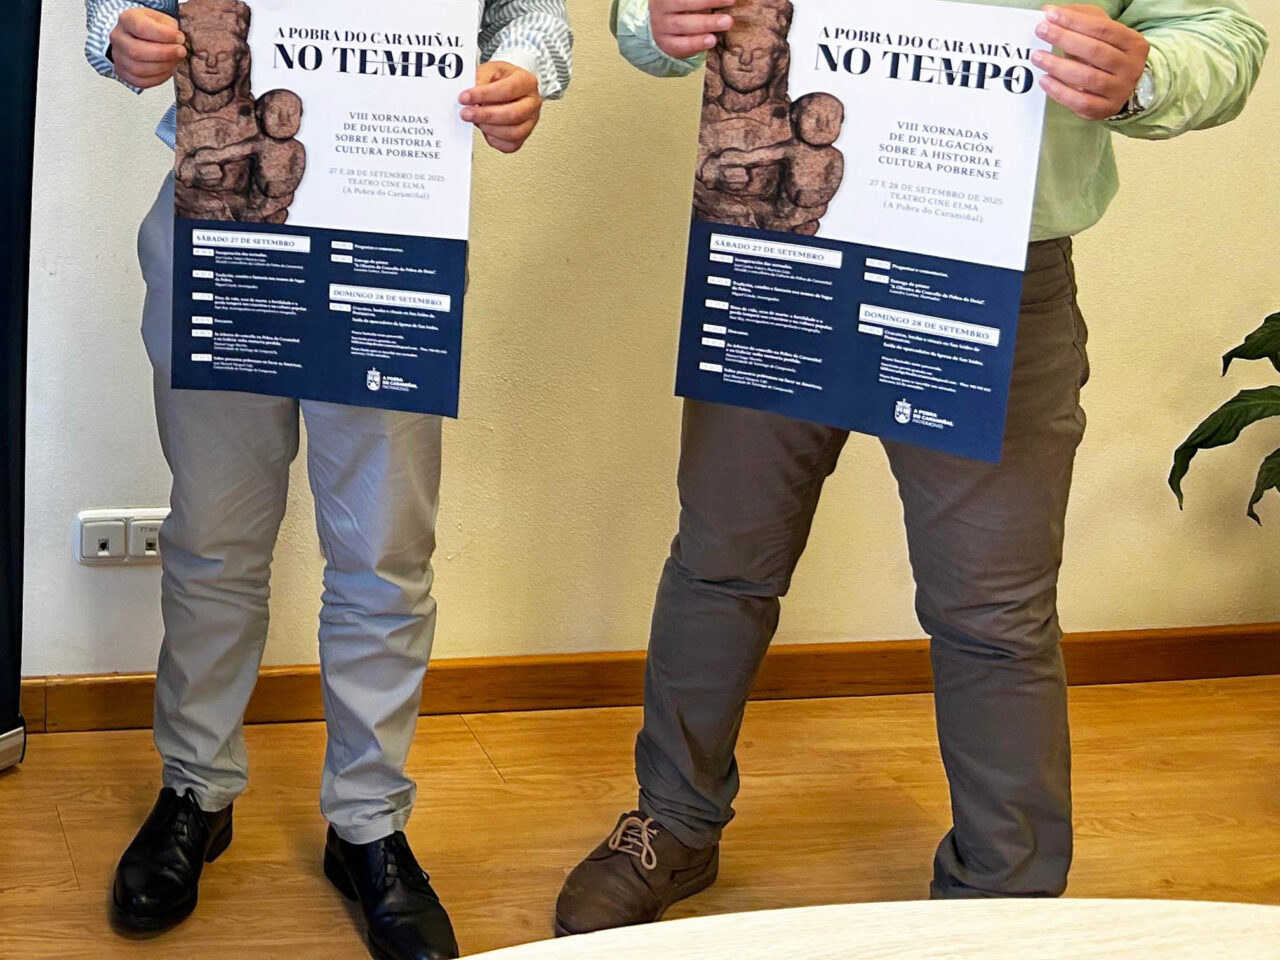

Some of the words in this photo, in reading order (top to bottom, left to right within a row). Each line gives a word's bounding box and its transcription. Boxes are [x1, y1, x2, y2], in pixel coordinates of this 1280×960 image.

[274, 27, 286, 38] A
[289, 27, 341, 41] POBRA
[345, 30, 366, 43] DO
[370, 32, 464, 48] CARAMIÑAL
[819, 26, 830, 39] A
[834, 27, 892, 45] POBRA
[898, 34, 924, 48] DO
[272, 44, 322, 70] NO
[333, 48, 463, 78] TEMPO
[814, 43, 871, 75] NO
[882, 50, 1034, 95] TEMPO
[350, 112, 367, 120] VIII
[372, 114, 428, 124] XORNADAS
[360, 124, 433, 135] DIVULGACIÓN
[898, 121, 918, 131] VIII
[923, 125, 988, 140] XORNADAS
[336, 134, 368, 143] SOBRE
[382, 137, 431, 147] HISTORIA
[890, 133, 904, 141] DE
[909, 135, 992, 153] DIVULGACIÓN
[336, 146, 382, 155] CULTURA
[386, 149, 440, 159] POBRENSE
[880, 144, 915, 155] SOBRE
[933, 151, 989, 166] HISTORIA
[878, 156, 932, 170] CULTURA
[937, 164, 998, 179] POBRENSE
